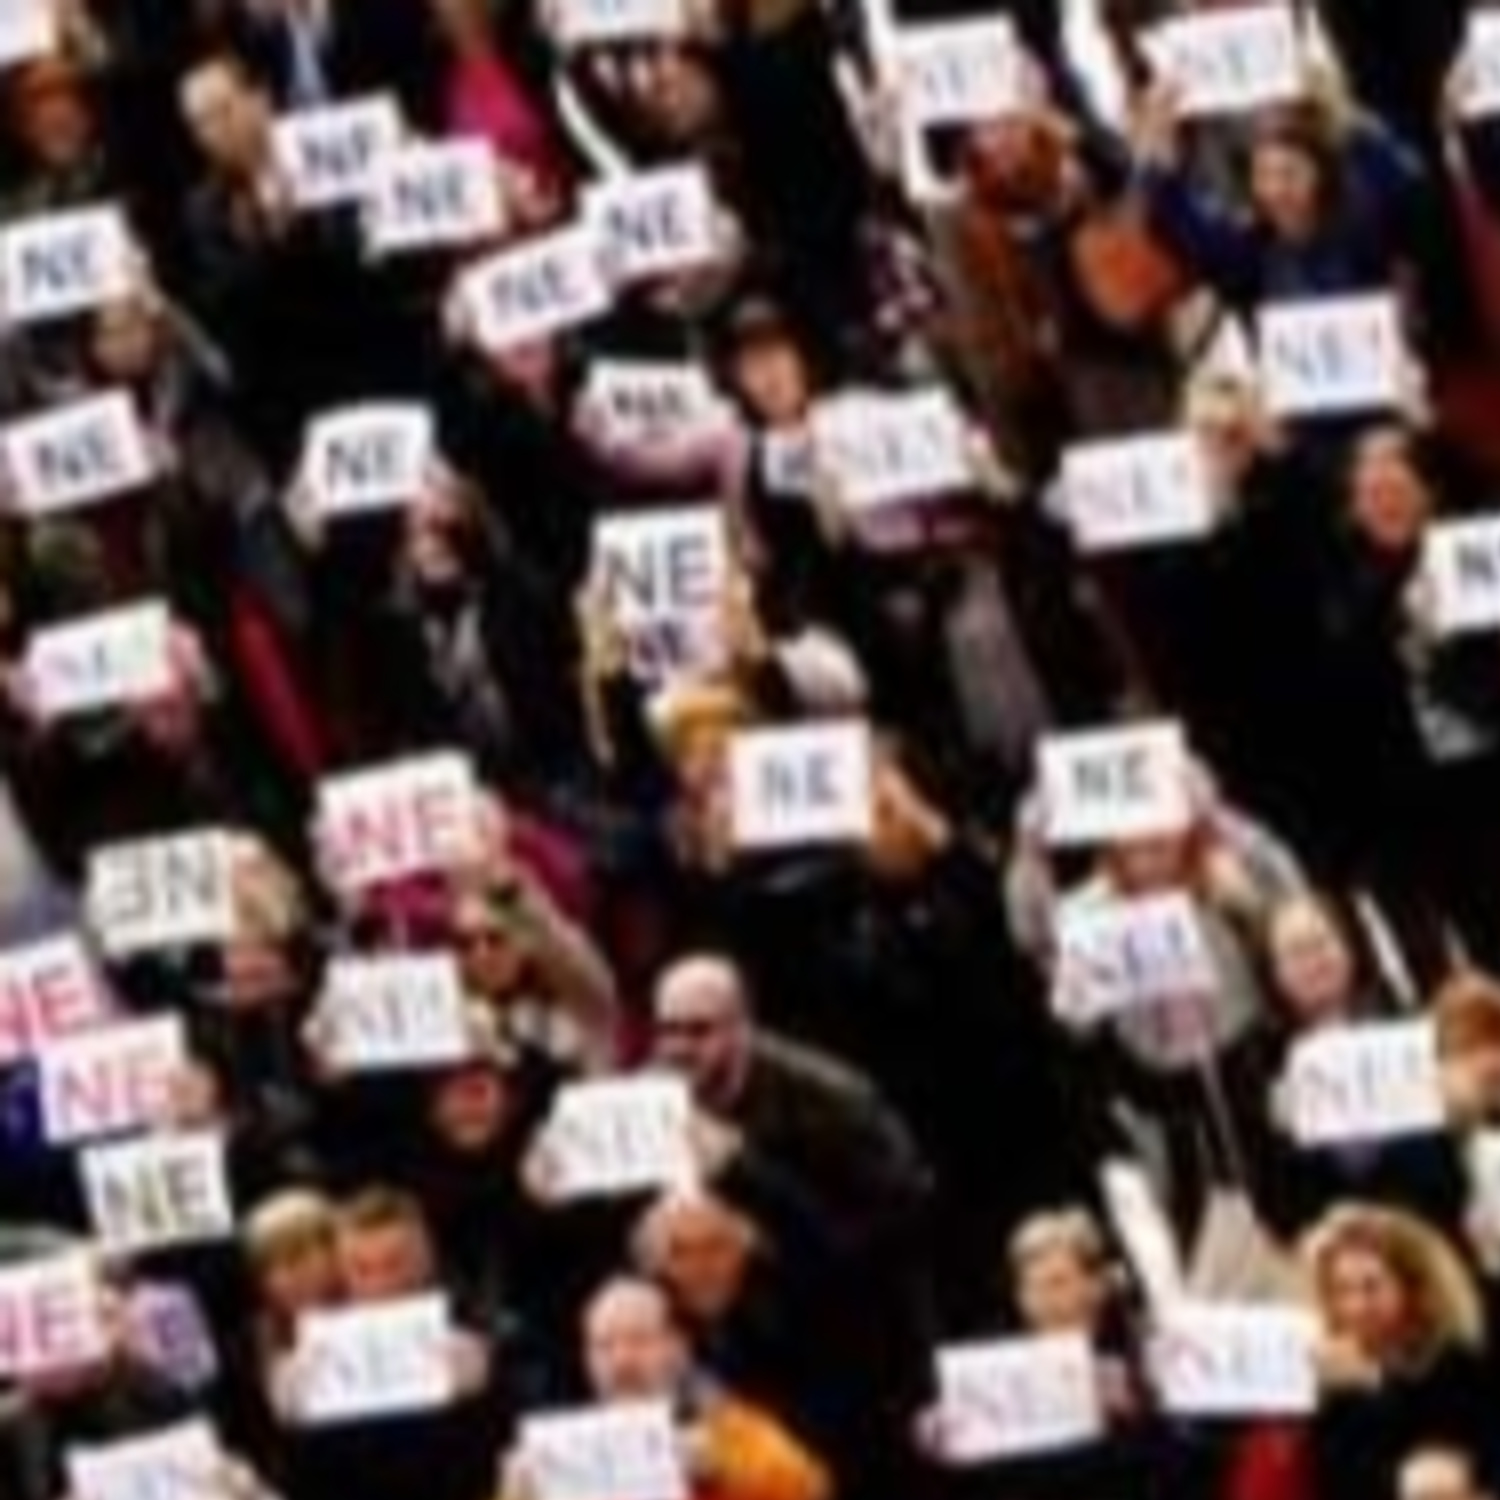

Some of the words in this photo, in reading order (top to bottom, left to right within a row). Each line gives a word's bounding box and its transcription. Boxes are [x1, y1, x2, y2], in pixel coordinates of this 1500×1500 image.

[606, 198, 682, 252] NE
[20, 225, 92, 292] NE
[36, 425, 122, 486] NE
[322, 434, 402, 490] NE
[600, 534, 712, 608] NE
[760, 748, 840, 806] NE
[1072, 750, 1156, 802] NE
[338, 788, 460, 862] NE
[57, 1056, 170, 1123] NE
[98, 1152, 206, 1226] NE
